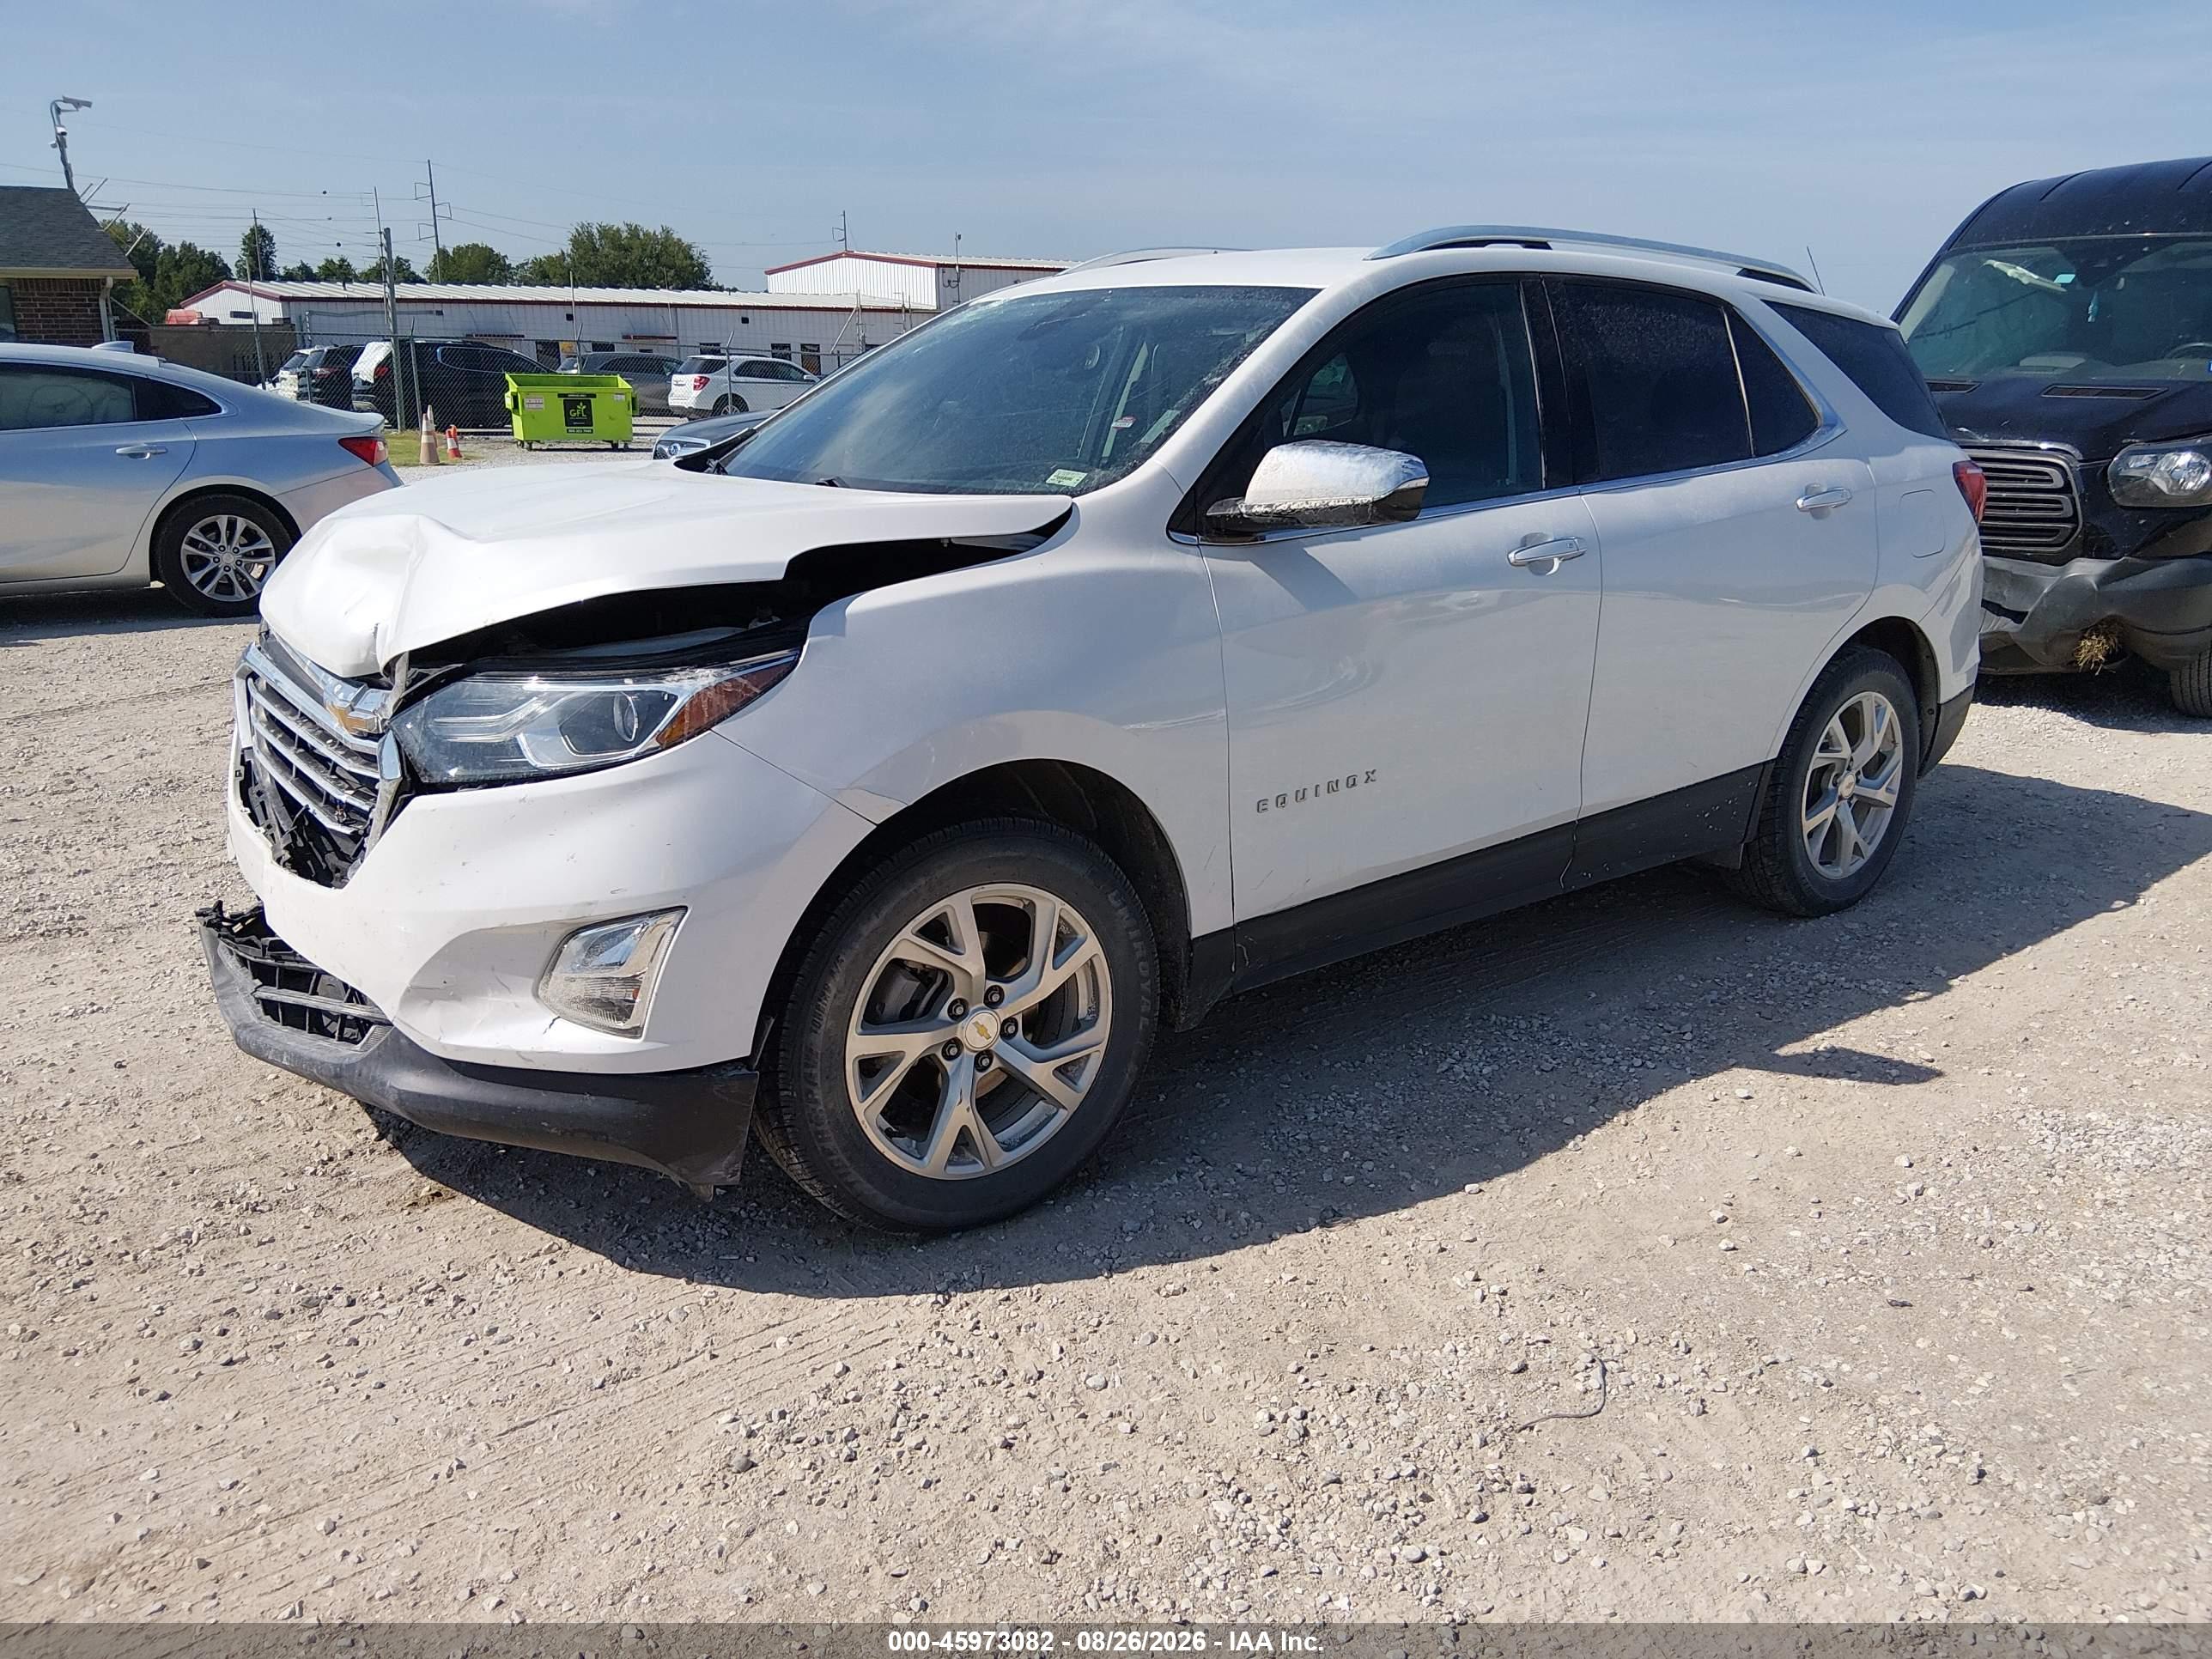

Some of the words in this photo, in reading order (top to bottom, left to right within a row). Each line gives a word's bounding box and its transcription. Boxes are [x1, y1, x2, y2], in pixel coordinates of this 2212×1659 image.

[569, 407, 587, 417] GFL
[1256, 769, 1377, 813] EQUINOX
[1108, 888, 1152, 1036] UNIROYAL
